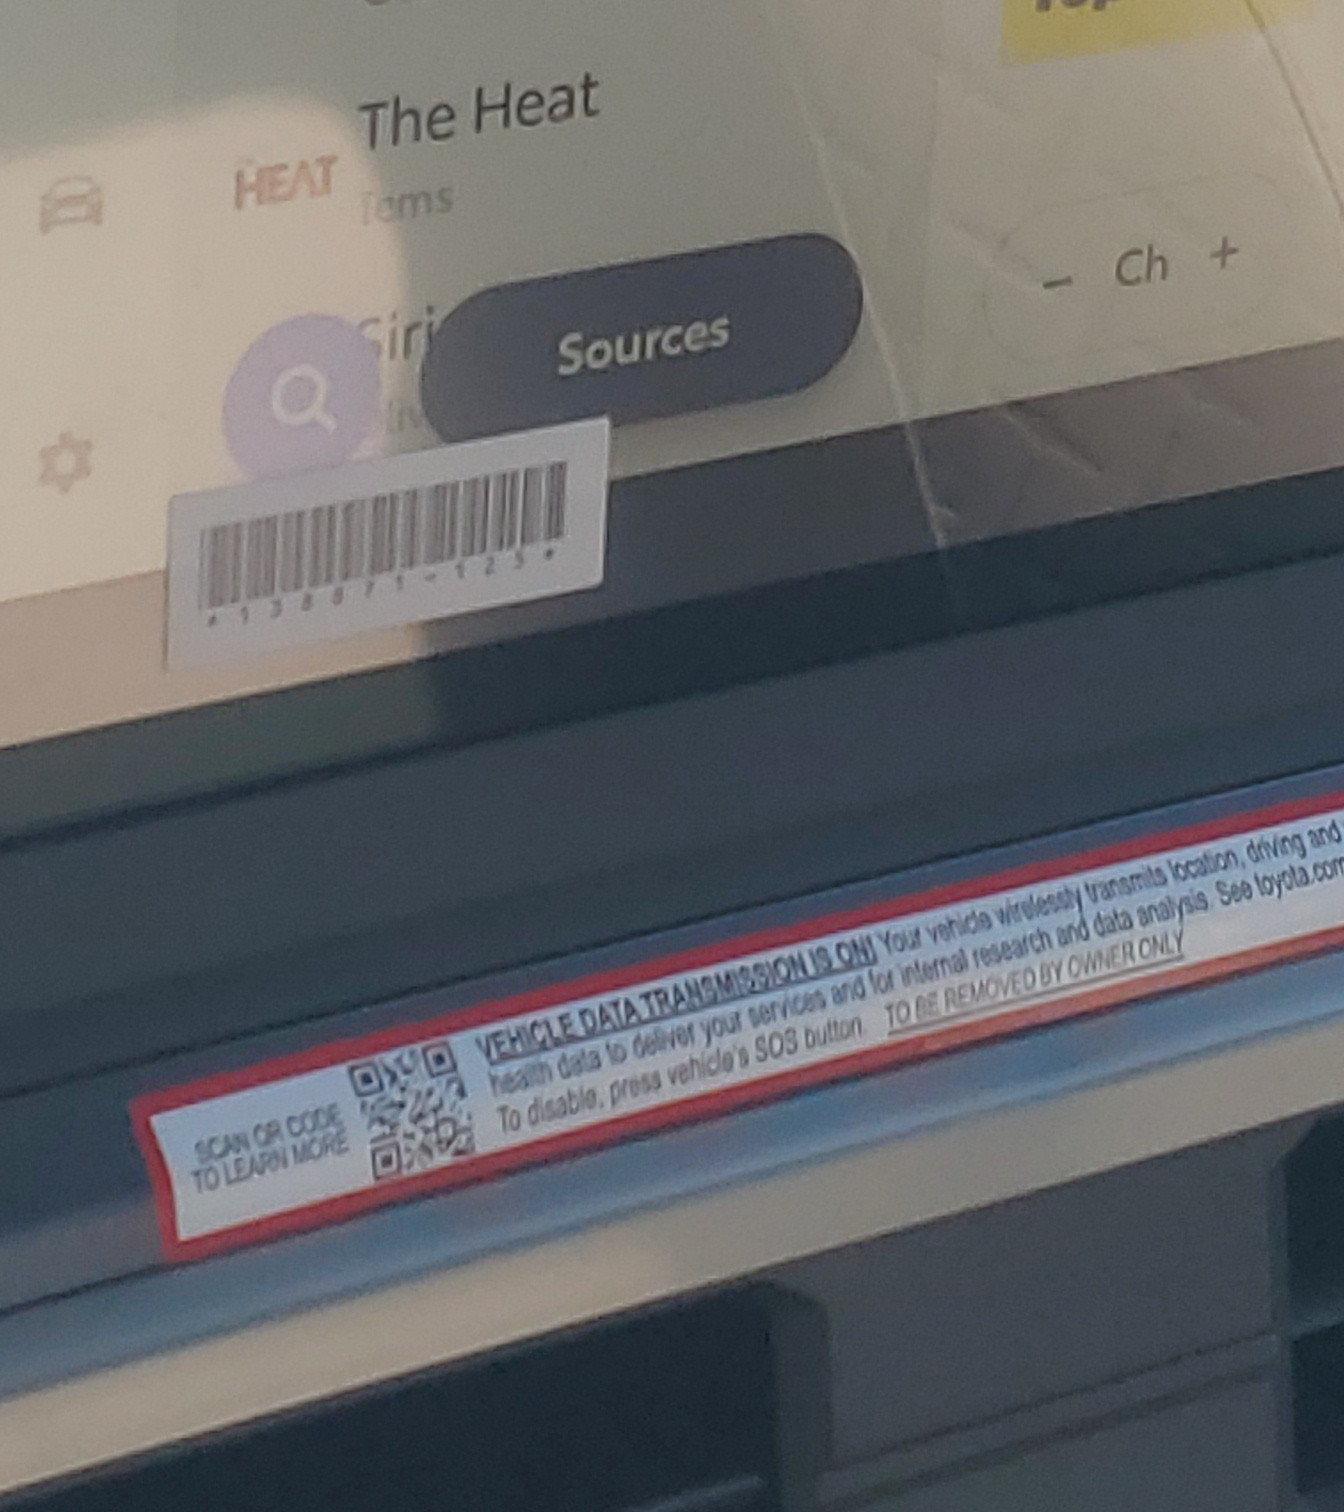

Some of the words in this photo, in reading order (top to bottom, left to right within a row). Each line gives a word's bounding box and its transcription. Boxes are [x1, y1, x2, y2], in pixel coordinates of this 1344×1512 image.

[359, 94, 457, 150] The
[473, 71, 601, 135] Heat
[233, 155, 339, 211] HEAT
[360, 187, 455, 226] Tems
[1114, 243, 1168, 287] Ch
[557, 312, 731, 378] Sources
[475, 1012, 574, 1065] VEHICLE
[578, 996, 640, 1037] DATA
[639, 950, 809, 1018] TRANSMISSION
[809, 945, 833, 976] IS
[878, 927, 921, 955] Your
[924, 909, 994, 943] vehicle
[994, 886, 1084, 926] wirelessly
[1084, 865, 1168, 904] transmits
[1167, 849, 1247, 882] location,
[1246, 832, 1307, 864] driving
[1307, 819, 1343, 848] and
[488, 1060, 553, 1097] health
[557, 1049, 603, 1080] data
[605, 1039, 628, 1065] to
[632, 1021, 695, 1060] deliver
[699, 1011, 743, 1048] your
[748, 989, 827, 1029] services
[830, 974, 866, 1005] and
[867, 968, 894, 995] for
[898, 947, 969, 987] internal
[970, 927, 1053, 969] research
[1056, 915, 1090, 946] and
[1093, 909, 1134, 938] data
[1215, 879, 1253, 906] See
[496, 1104, 521, 1135] To
[609, 1069, 662, 1108] press
[667, 1046, 750, 1086] vehicle's
[755, 1026, 798, 1063] SOS
[884, 999, 911, 1029] TO
[915, 990, 938, 1020] BE
[944, 967, 1037, 1011] REMOVED
[1040, 959, 1064, 988] BY
[1067, 939, 1136, 978] OWNER
[1138, 928, 1184, 960] ONLY
[190, 1165, 220, 1194] TO
[222, 1147, 289, 1186] LEARN
[292, 1126, 349, 1165] MORE
[193, 1131, 251, 1165] SCAN
[285, 1102, 343, 1138] CODE
